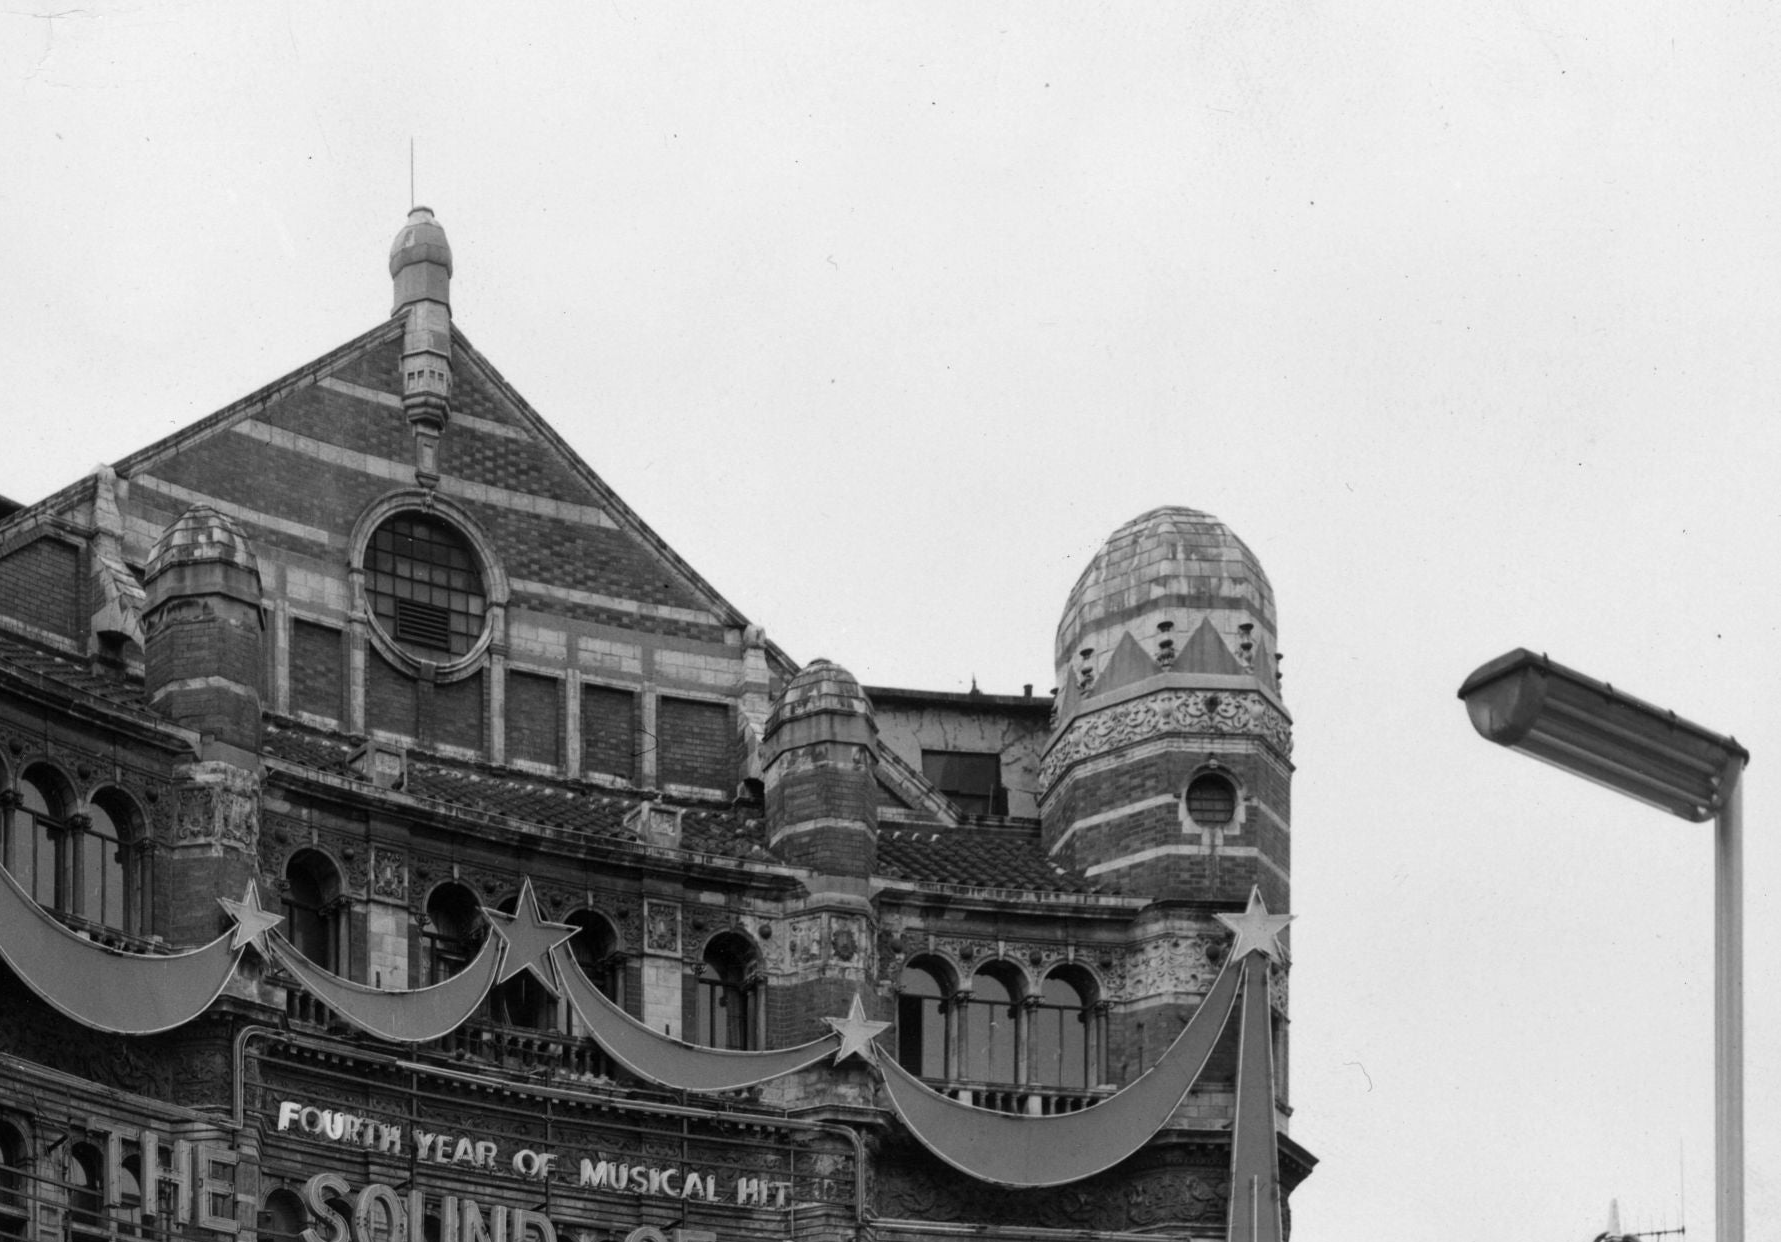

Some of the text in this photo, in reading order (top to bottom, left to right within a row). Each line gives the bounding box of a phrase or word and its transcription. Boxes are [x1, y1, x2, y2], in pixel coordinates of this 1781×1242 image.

[86, 1116, 239, 1234] THE
[278, 1101, 792, 1208] FOURTH YEAR OF MUSICAL HIT
